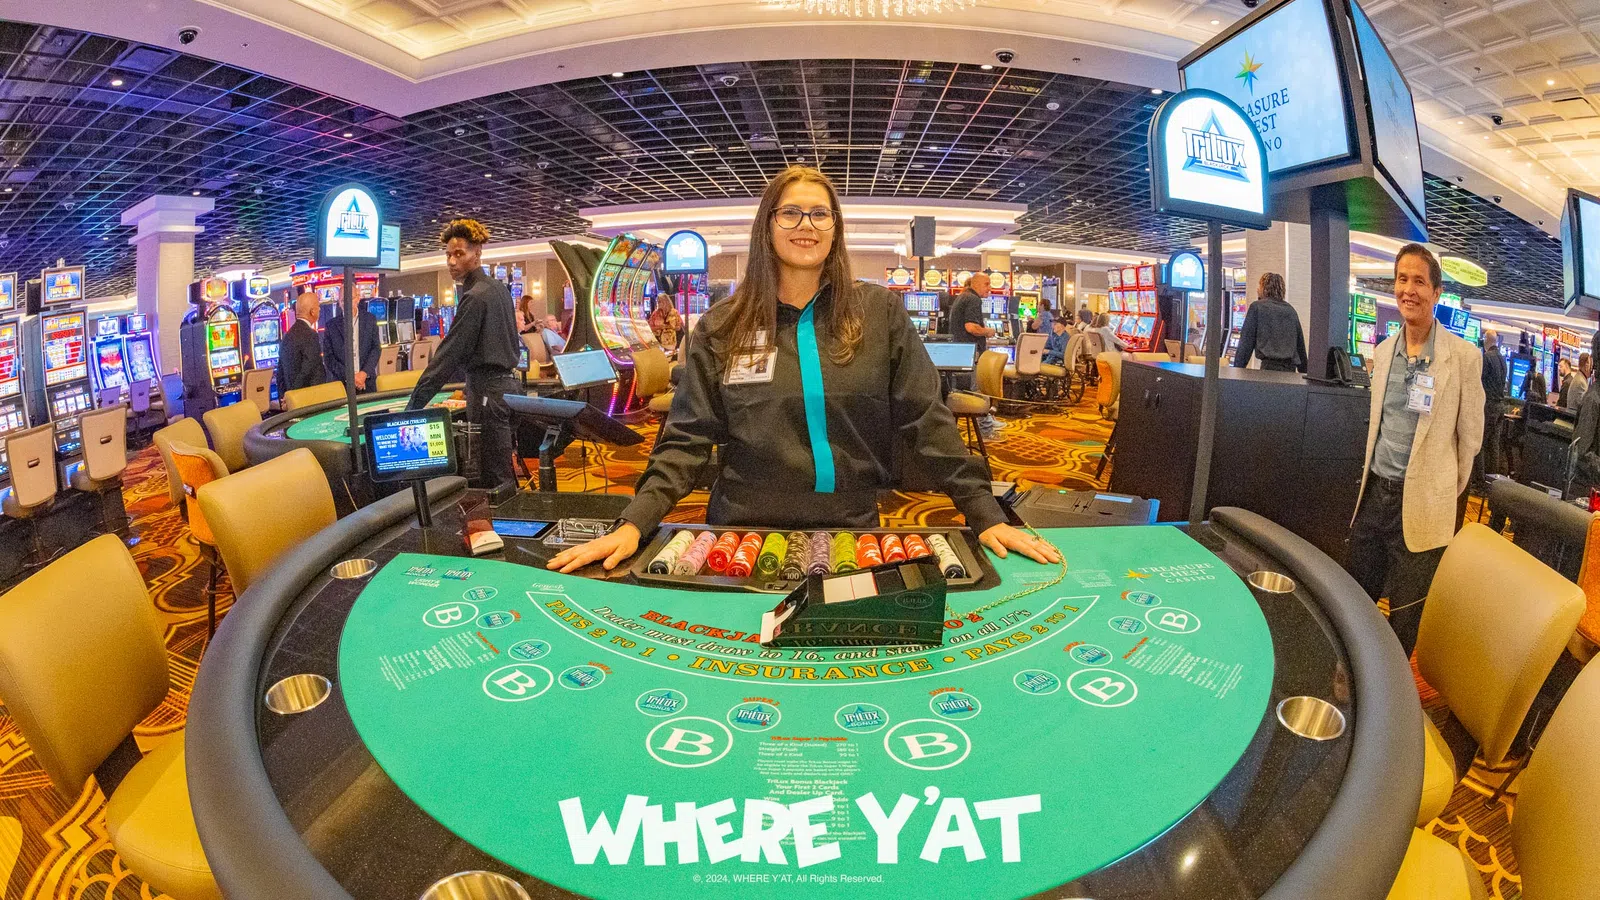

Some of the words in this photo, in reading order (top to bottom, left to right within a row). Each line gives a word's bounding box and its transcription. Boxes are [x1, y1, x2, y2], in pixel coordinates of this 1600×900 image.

[1242, 88, 1290, 117] ASURE
[1254, 112, 1276, 134] EST
[1138, 562, 1214, 573] TREASURE
[1160, 569, 1207, 578] CHEST
[1165, 574, 1216, 584] CASINO
[434, 606, 462, 624] B
[639, 609, 761, 644] BLACKJA
[944, 619, 964, 629] O
[1159, 612, 1188, 631] B
[545, 600, 594, 630] PAYS
[588, 628, 608, 639] 2
[610, 635, 637, 649] TO
[639, 647, 657, 657] 1
[688, 656, 934, 680] INSURANCE
[961, 631, 1032, 661] PAYS
[1030, 624, 1049, 634] 2
[1044, 612, 1066, 624] TO
[592, 606, 645, 631] Dealer
[644, 626, 696, 646] must
[696, 641, 754, 656] draw
[758, 649, 782, 660] to
[789, 650, 825, 662] 16,
[834, 647, 879, 660] and
[949, 632, 974, 644] on
[977, 621, 1001, 636] all
[999, 609, 1032, 626] 17's
[492, 669, 537, 696] B
[1078, 677, 1126, 703] B
[657, 727, 714, 756] B
[898, 732, 958, 760] B
